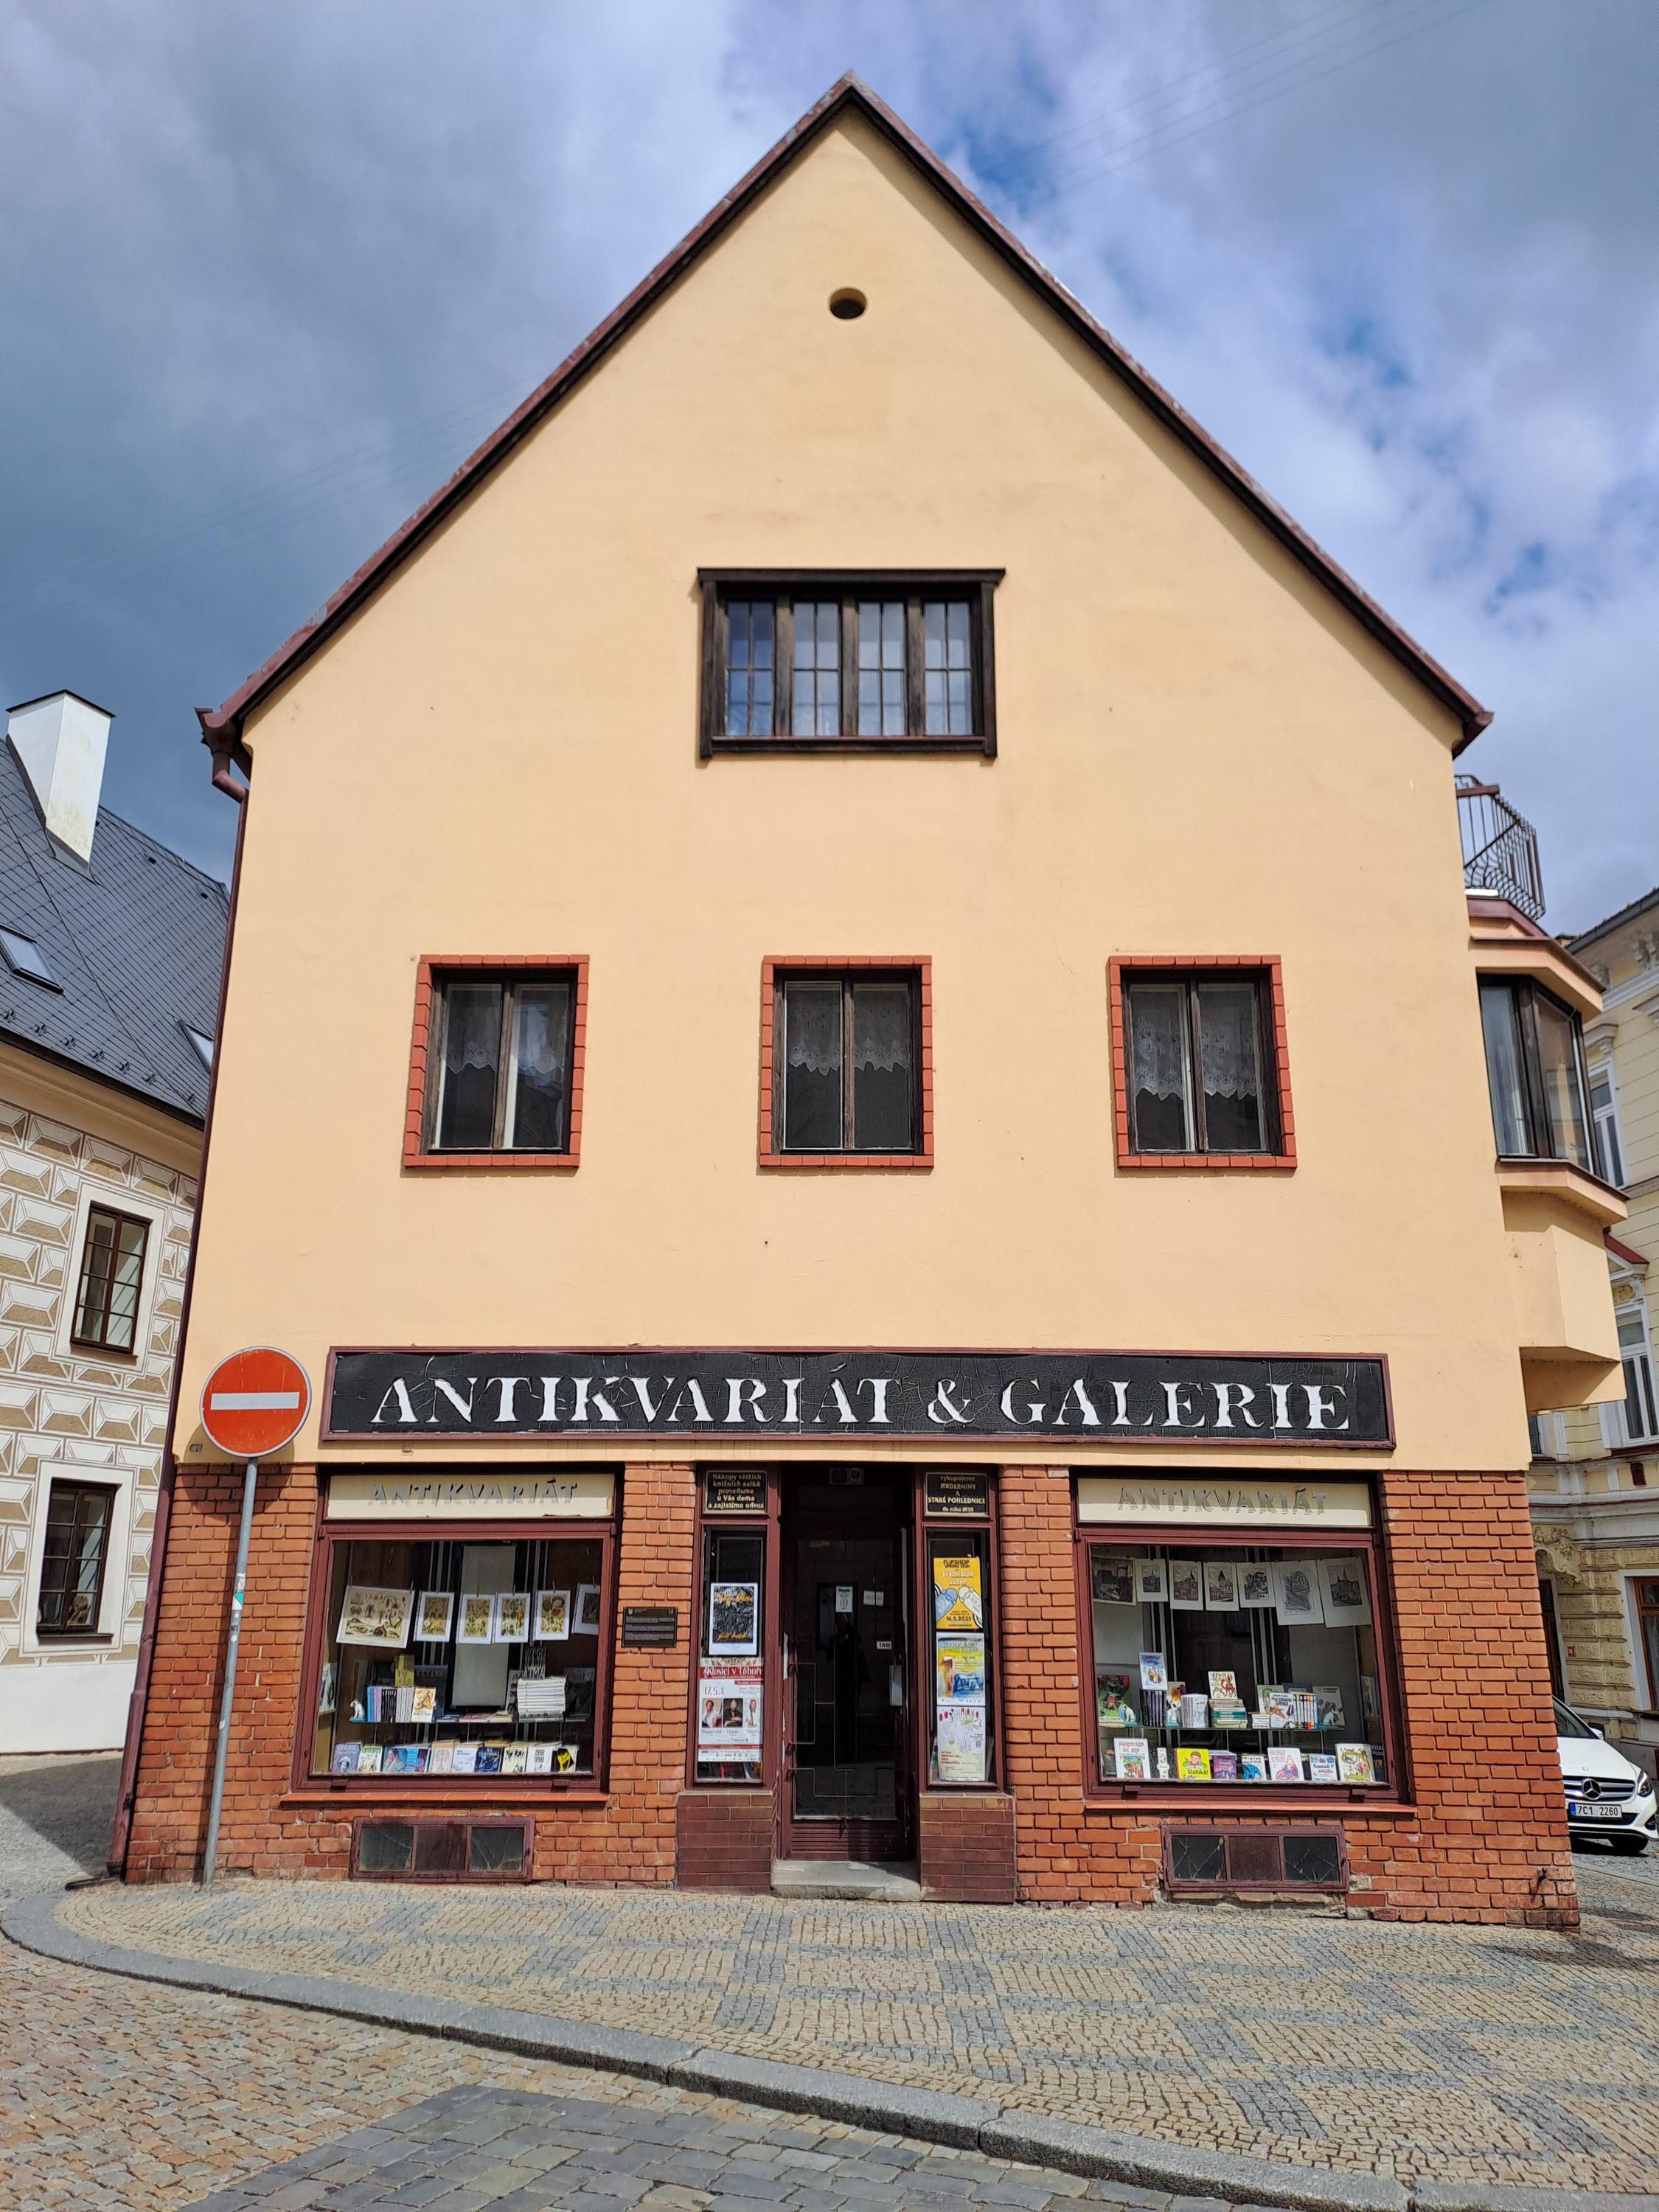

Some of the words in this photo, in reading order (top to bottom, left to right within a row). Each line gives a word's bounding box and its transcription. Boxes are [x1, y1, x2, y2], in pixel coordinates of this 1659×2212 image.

[369, 1363, 903, 1424] ANTIKVARIÁT
[928, 1378, 975, 1424] &
[1000, 1377, 1349, 1430] GALERIE
[367, 1478, 578, 1506] ANTIKVARIÁT
[1117, 1486, 1326, 1514] ANTIKVARIÁT
[1578, 1806, 1593, 1815] 7C1
[1599, 1807, 1618, 1816] 2260
